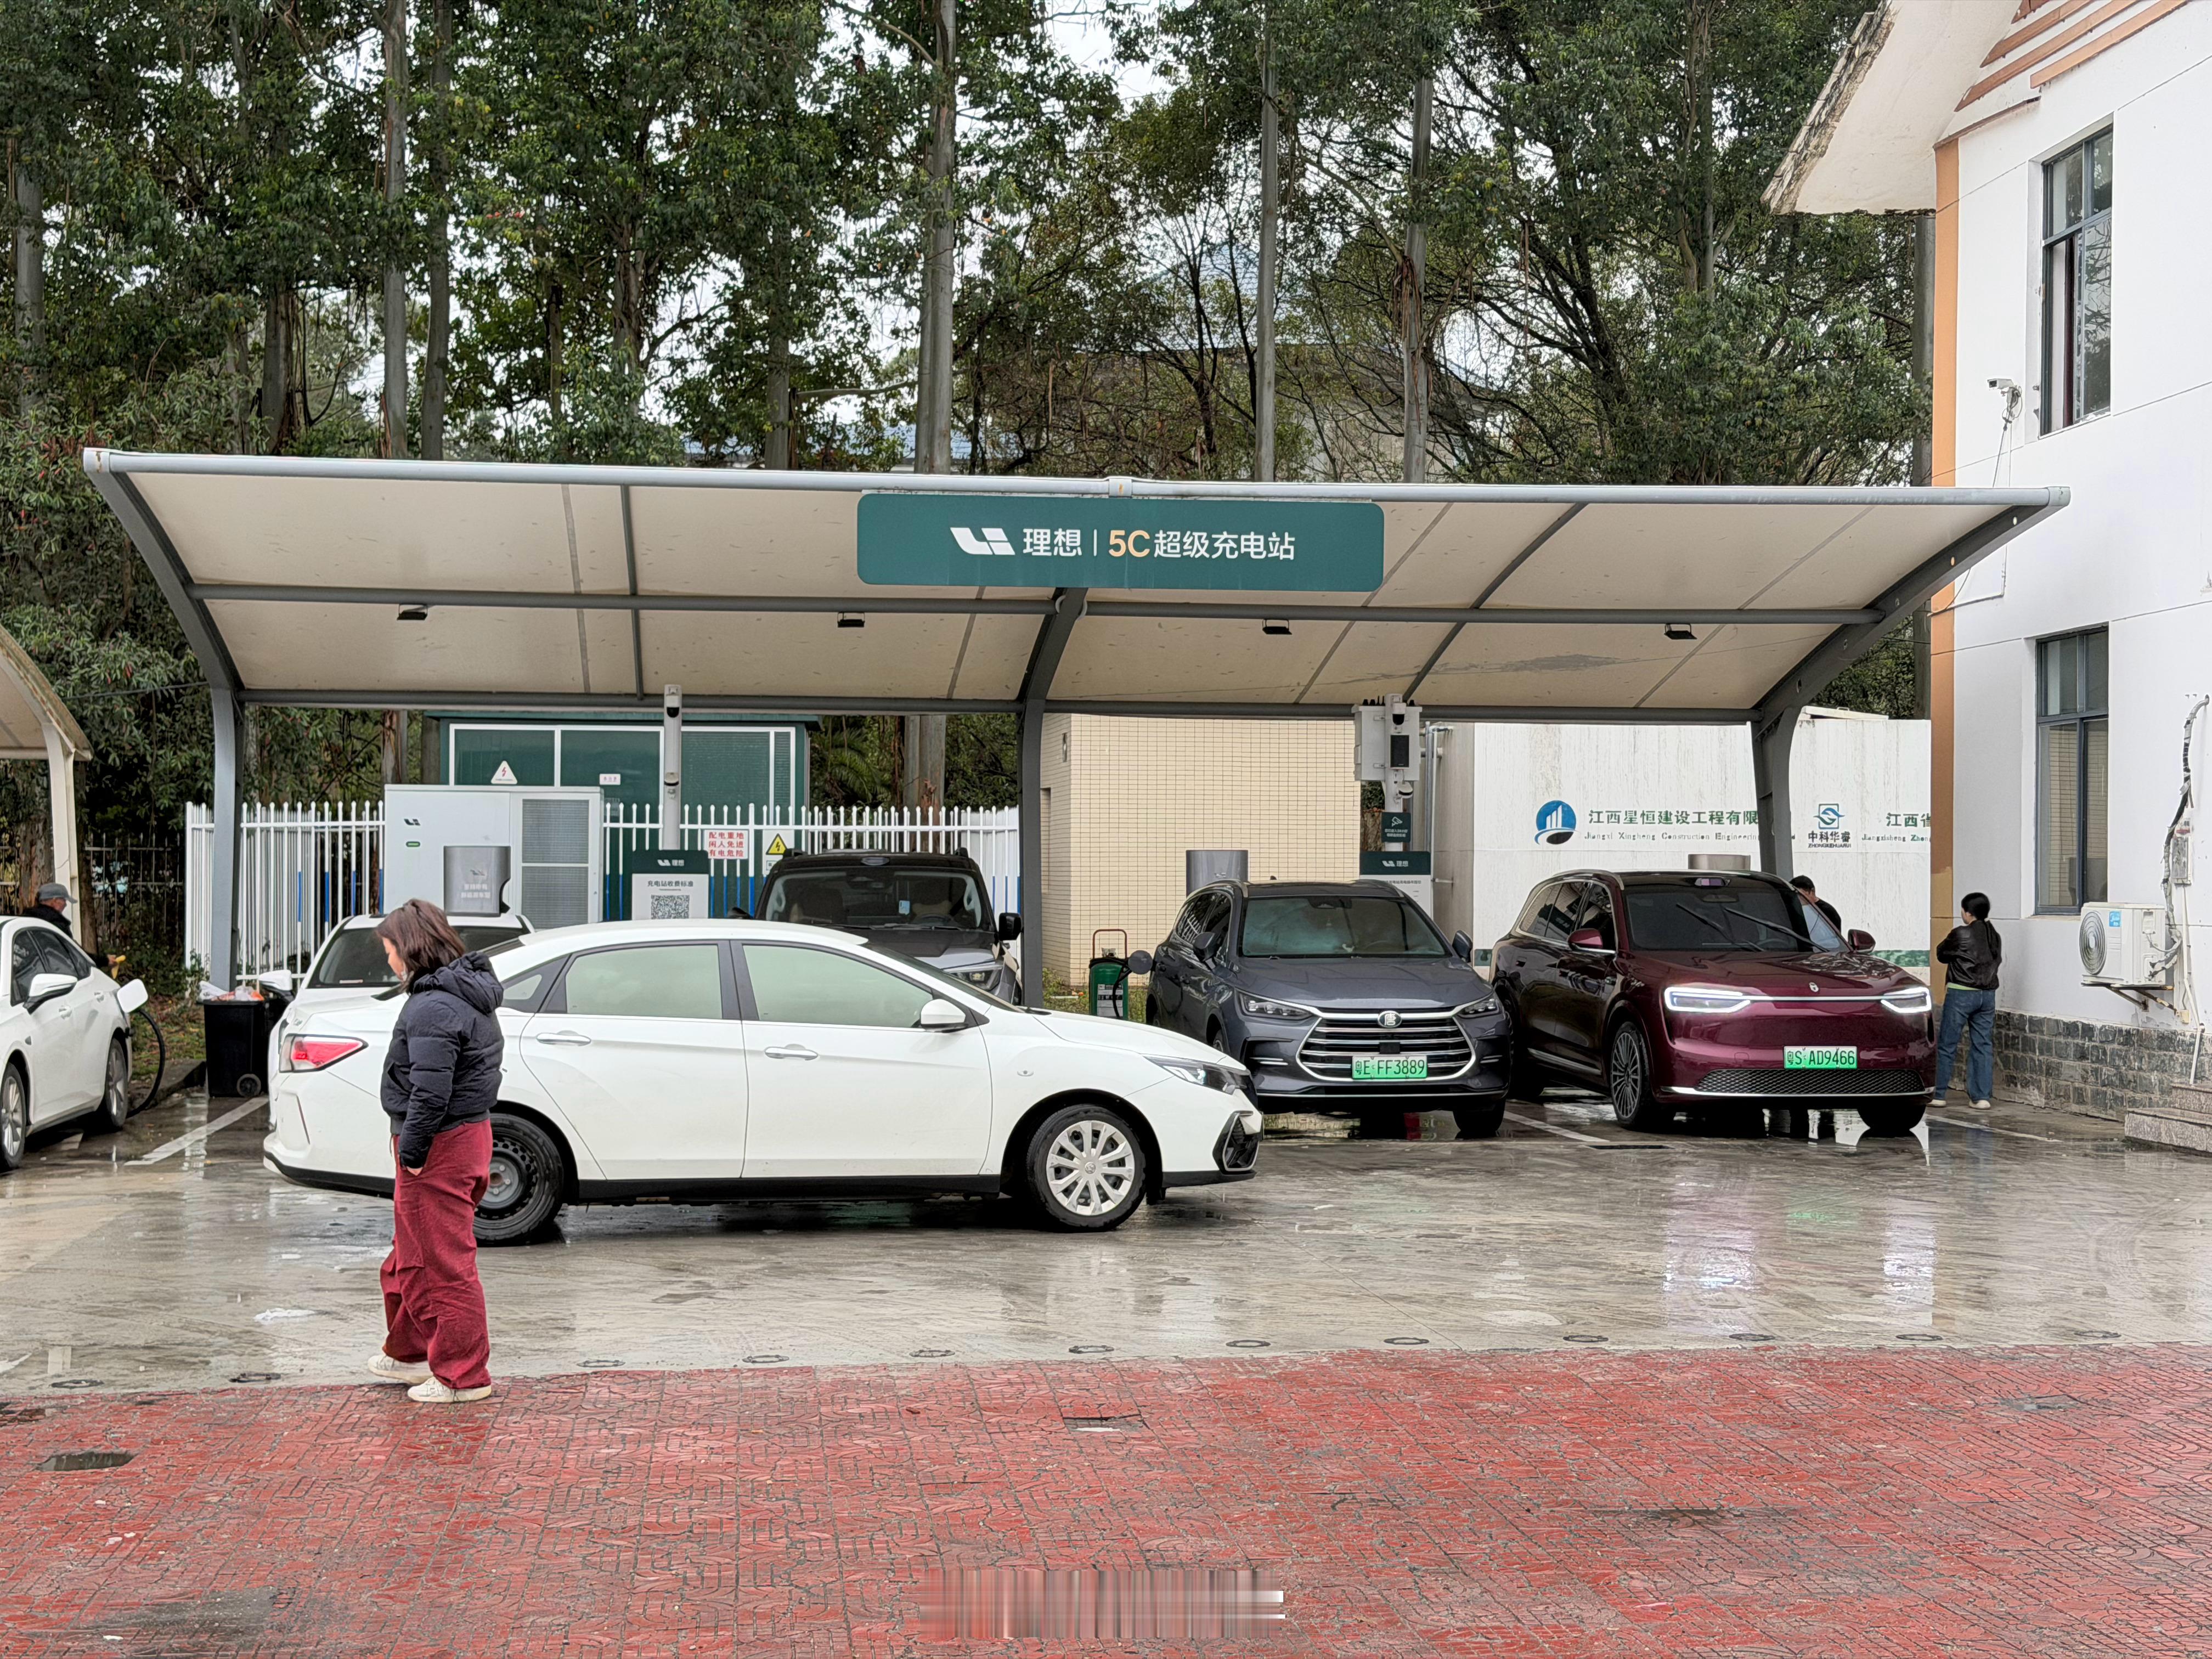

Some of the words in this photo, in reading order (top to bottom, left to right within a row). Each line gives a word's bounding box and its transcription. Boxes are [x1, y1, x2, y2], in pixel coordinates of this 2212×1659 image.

[1023, 528, 1082, 556] 理想
[1715, 832, 1759, 841] Engineerin
[1910, 834, 1931, 843] Zhon
[1809, 1050, 1855, 1065] AD9466
[1377, 1059, 1425, 1075] FF3889
